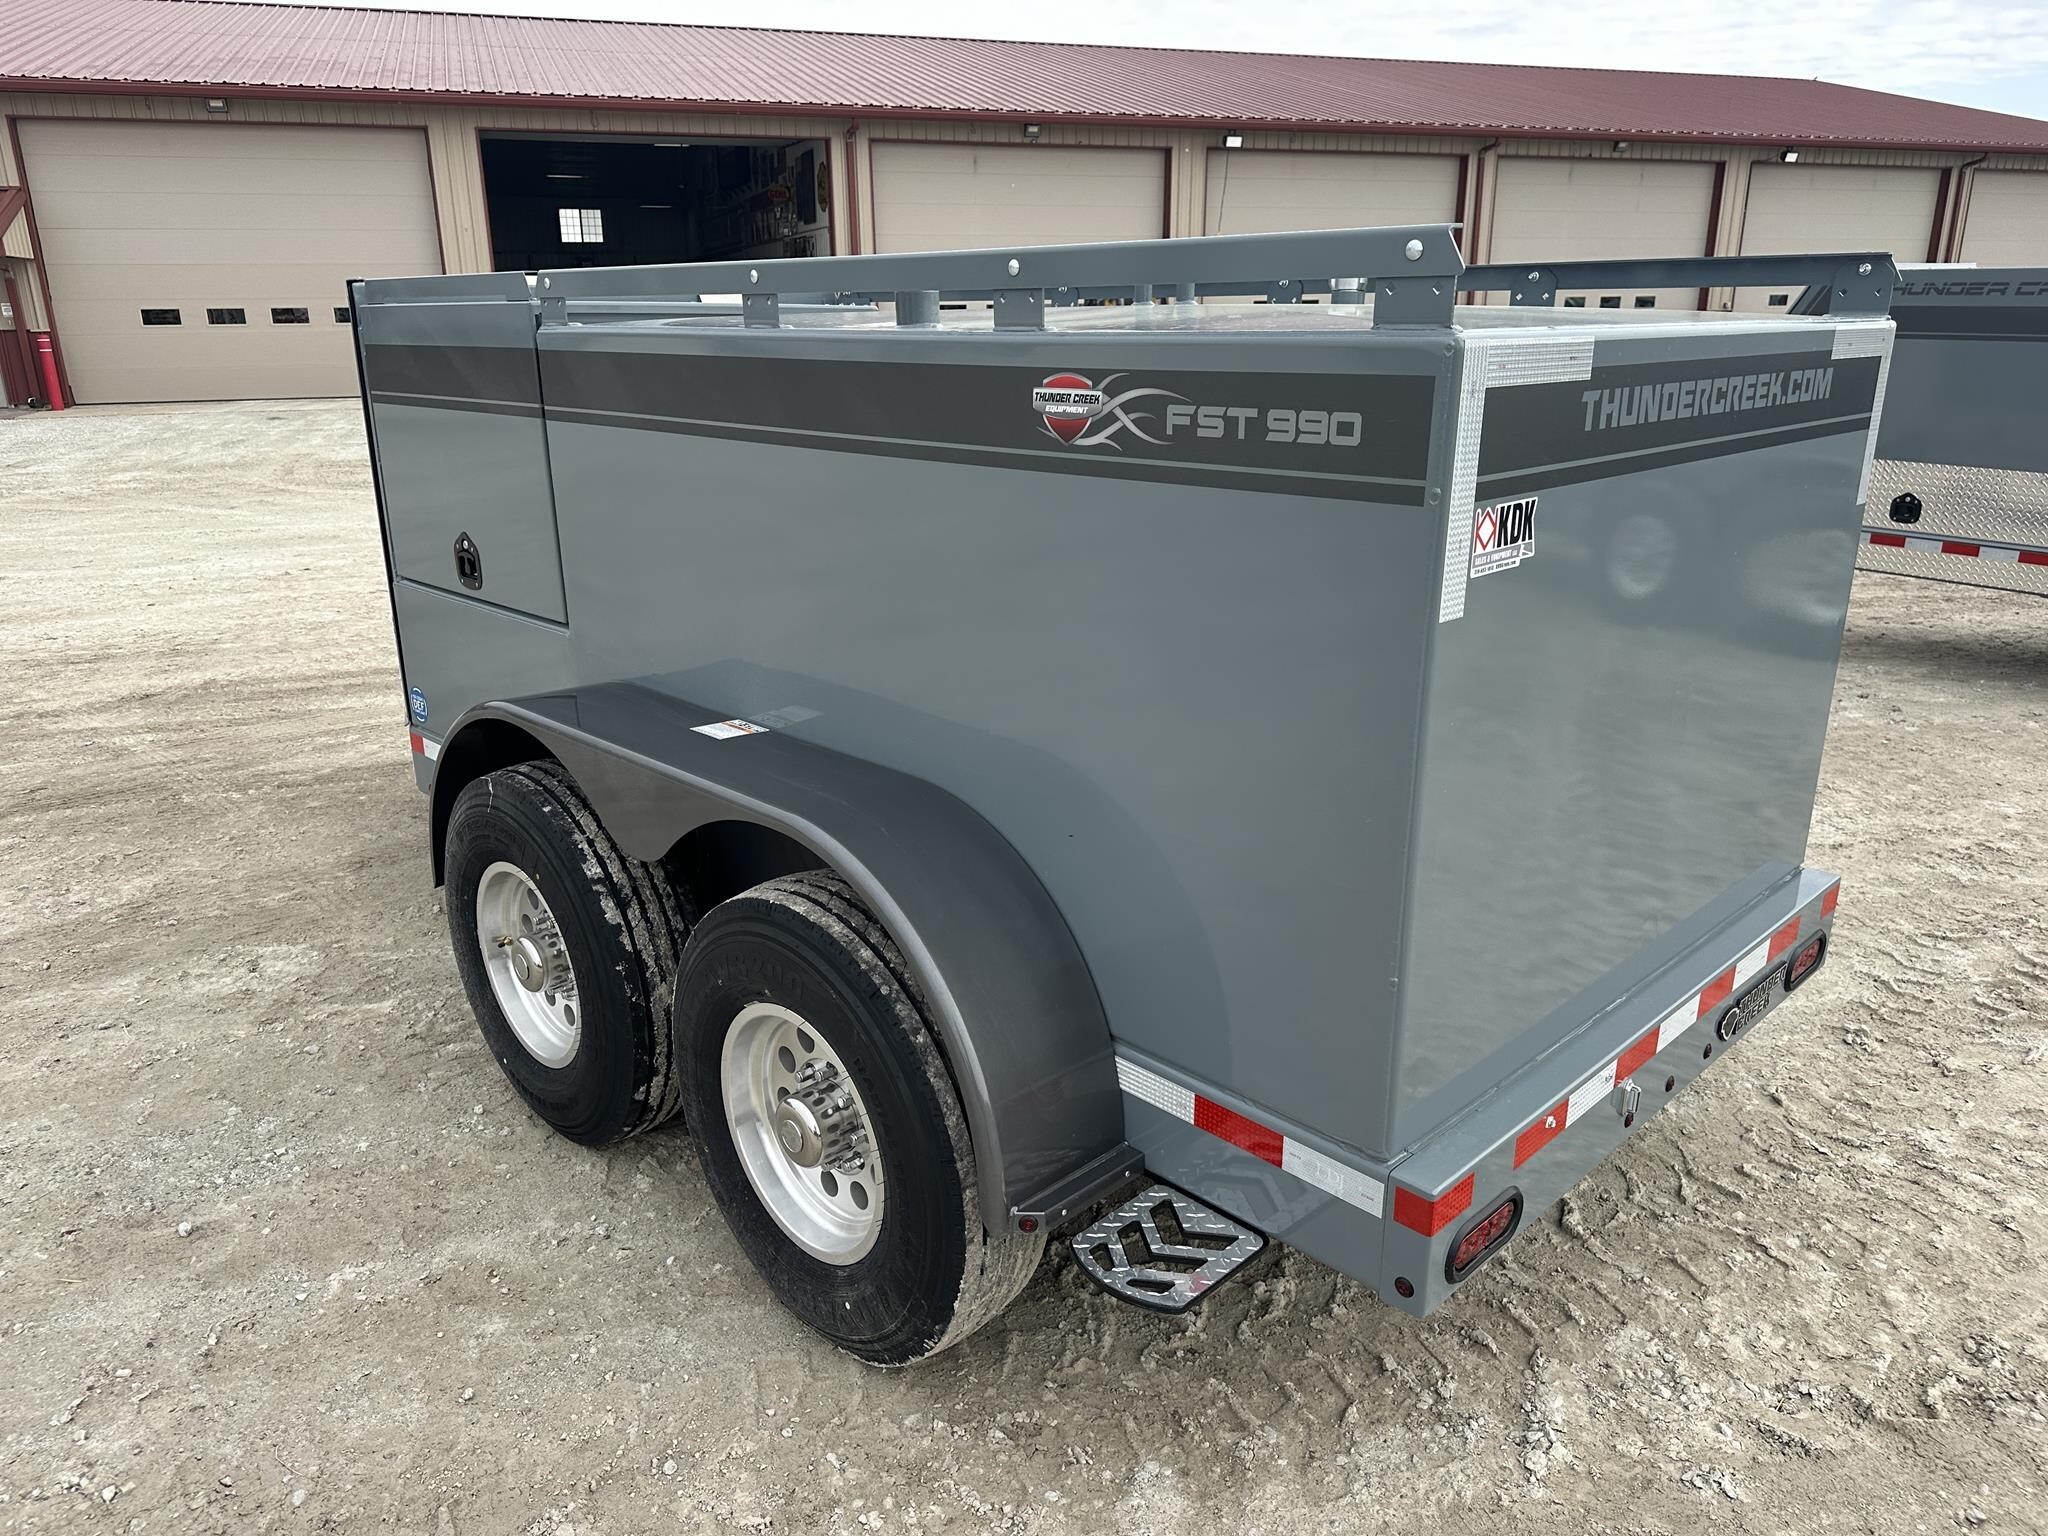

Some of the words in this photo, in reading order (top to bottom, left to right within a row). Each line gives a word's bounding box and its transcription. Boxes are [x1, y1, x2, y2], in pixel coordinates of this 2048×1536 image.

[1893, 281, 2010, 296] HUNDER
[1034, 391, 1072, 403] THUNDER
[1073, 393, 1101, 405] CREEK
[1045, 404, 1089, 414] EQUIPMENT
[1582, 367, 1834, 431] THUNDERCREEK.COM
[1165, 404, 1259, 440] FST
[1265, 408, 1363, 447] 990
[1496, 499, 1536, 548] KDK
[1739, 965, 1787, 1014] THUNDER
